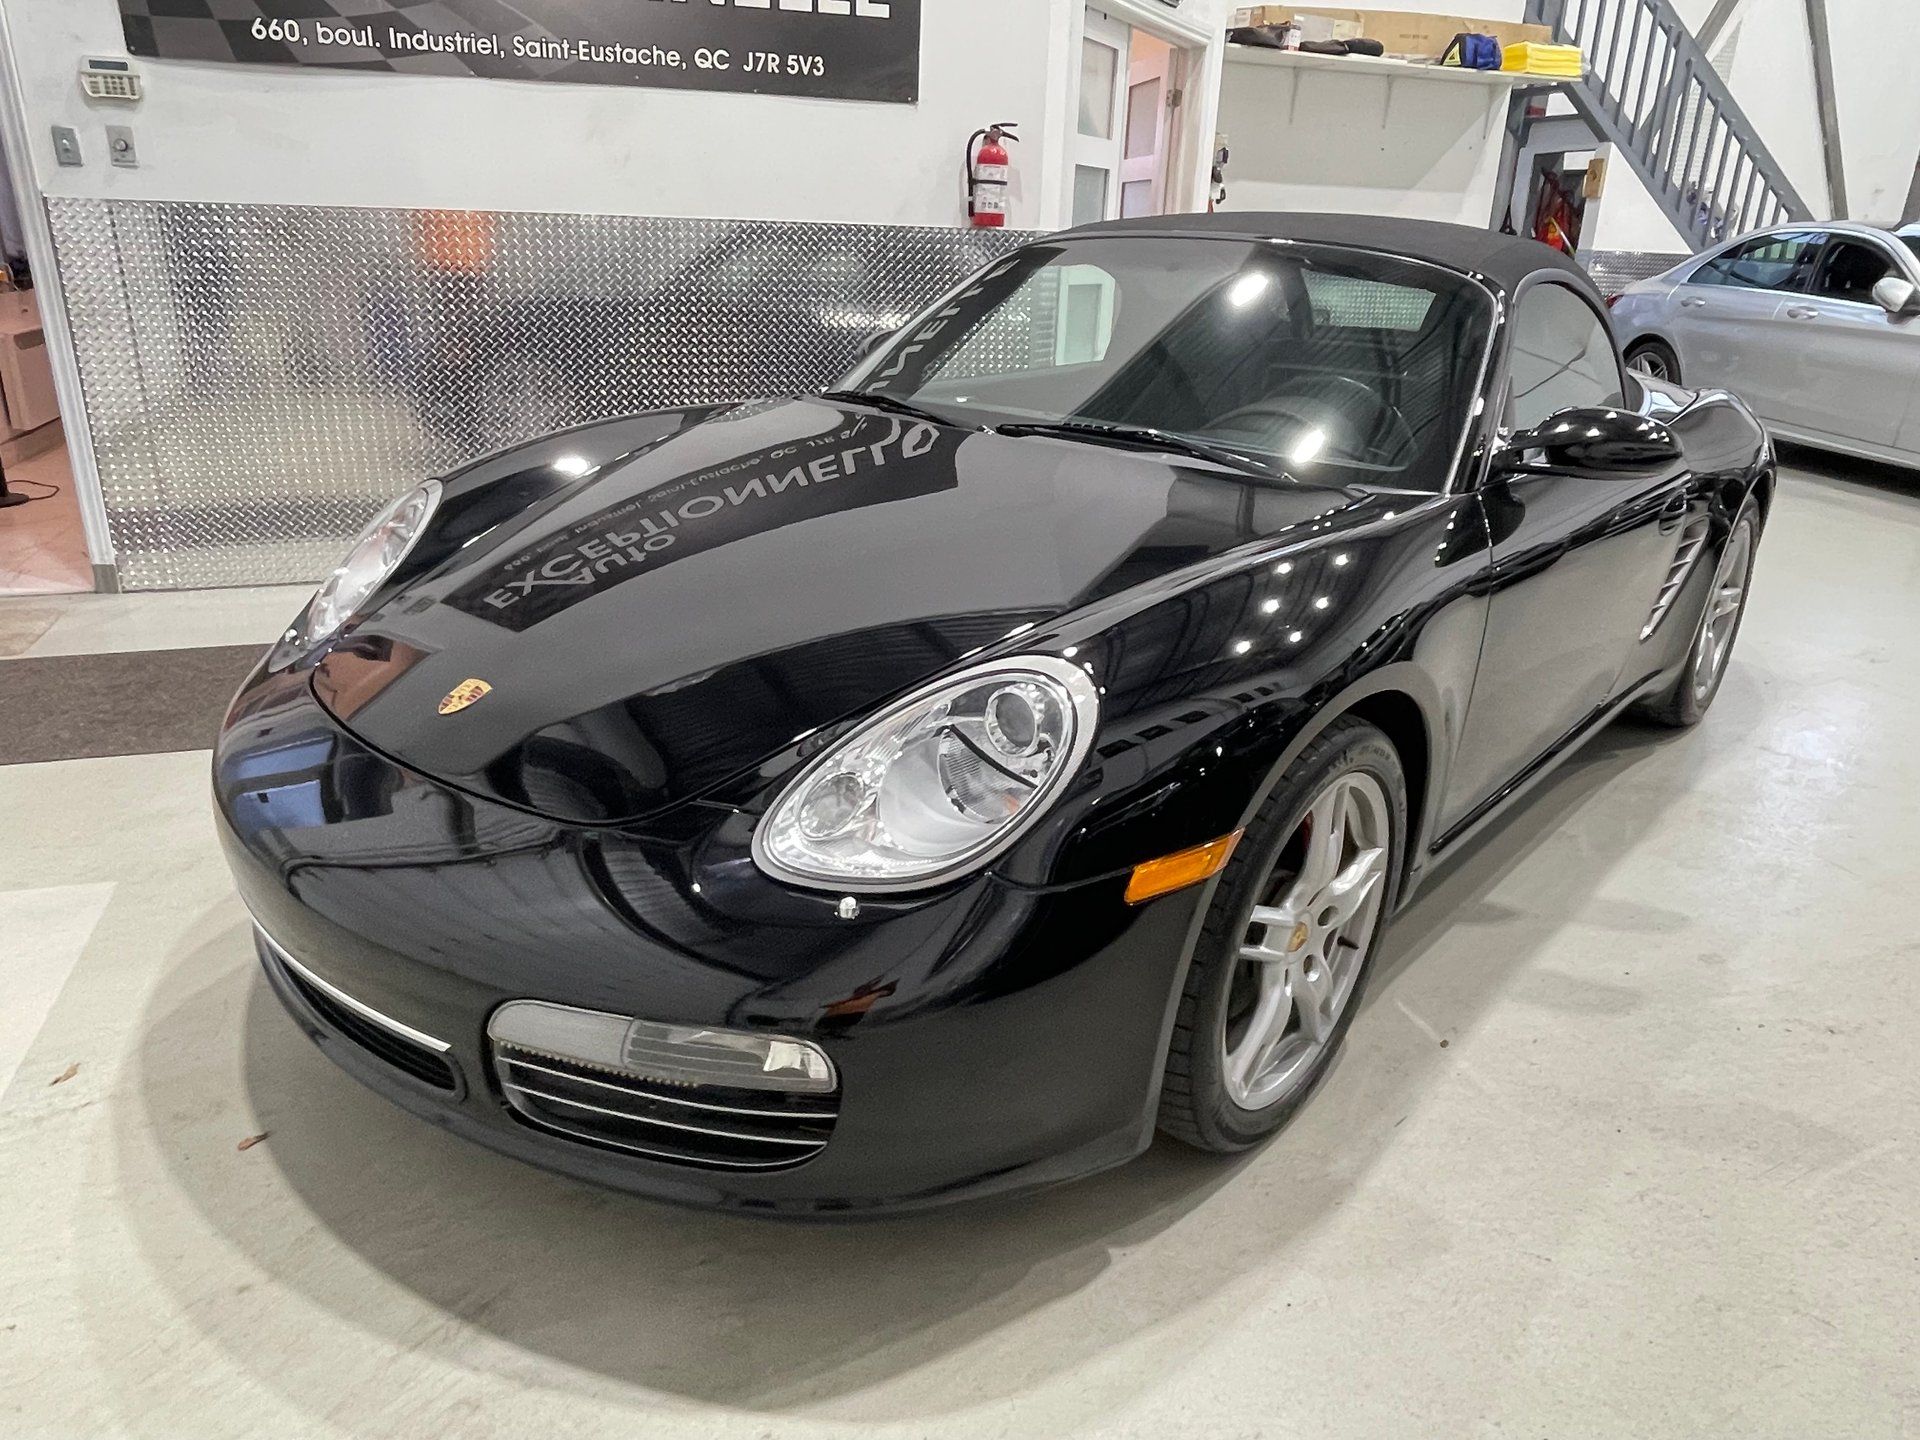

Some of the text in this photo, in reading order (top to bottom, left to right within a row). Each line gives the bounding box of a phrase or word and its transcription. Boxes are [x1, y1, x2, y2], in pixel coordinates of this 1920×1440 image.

[250, 17, 825, 77] 660, boul. Industriel, Saint-Eustache, QC J7R 5V3
